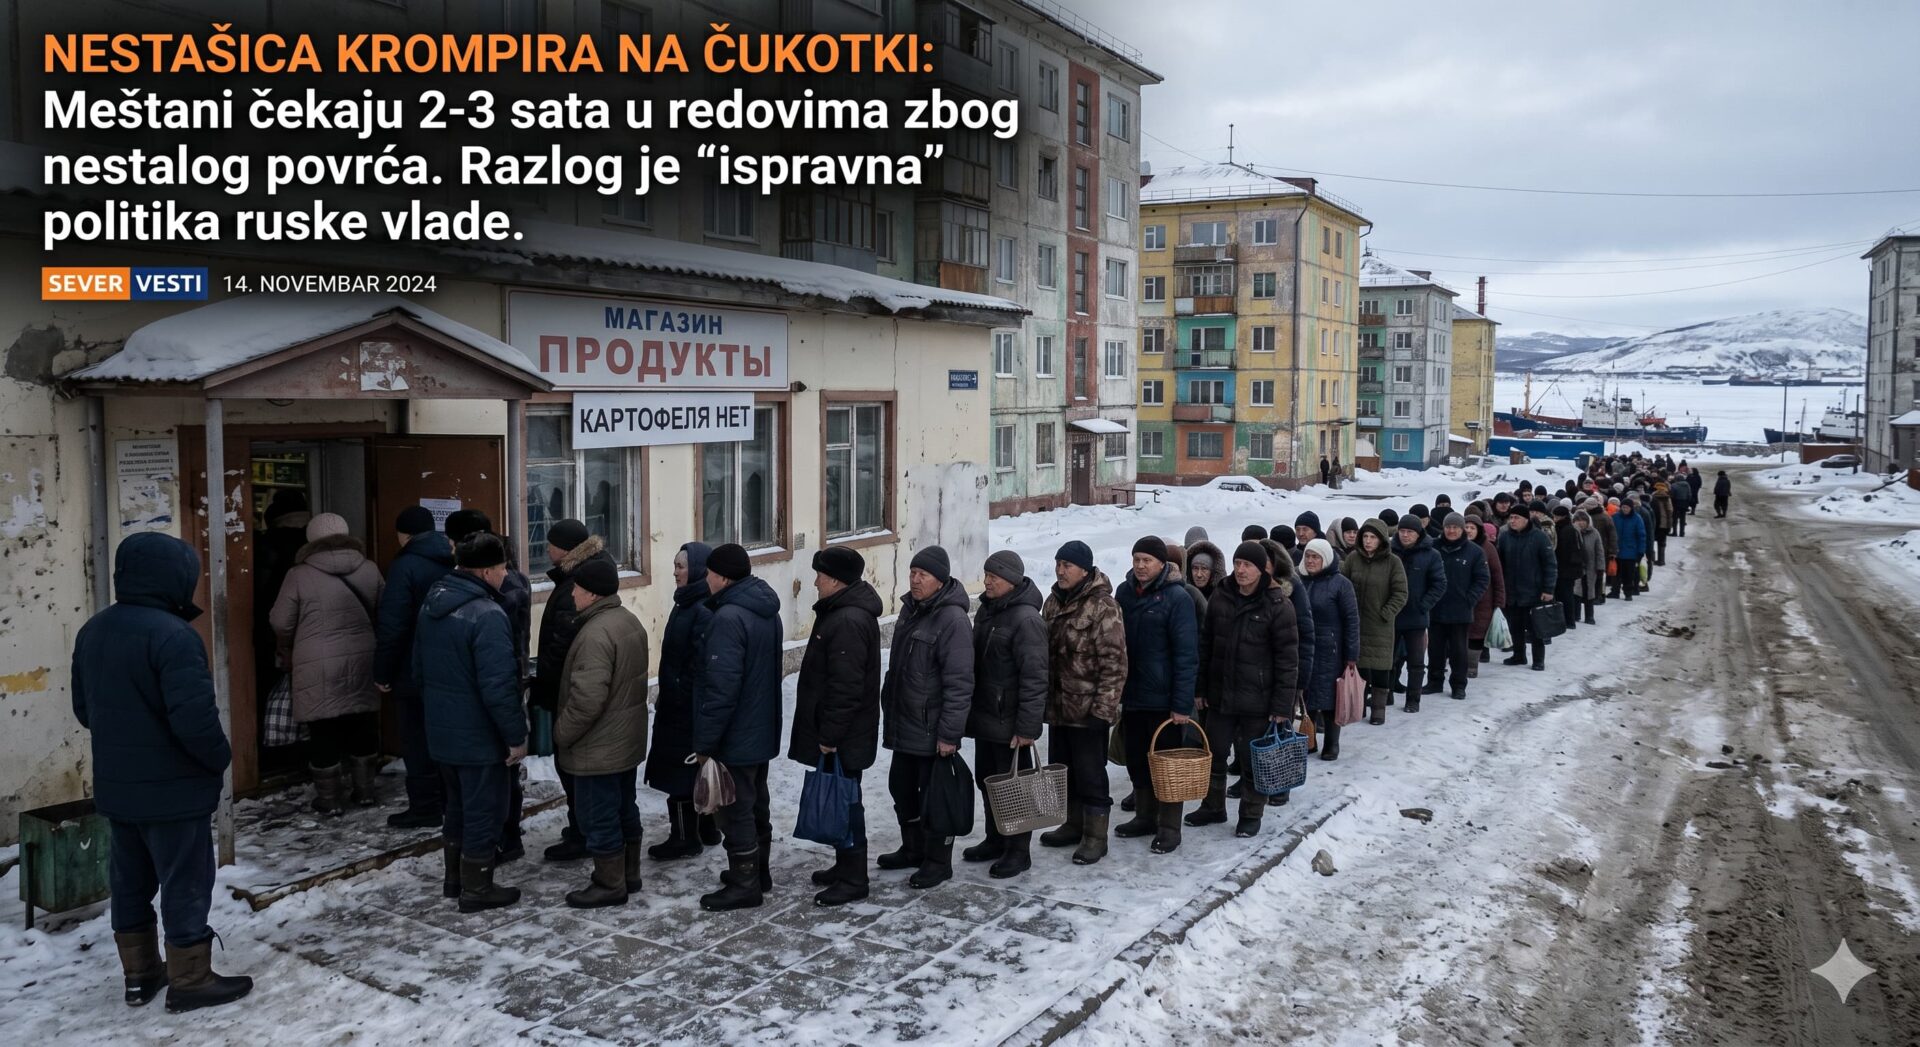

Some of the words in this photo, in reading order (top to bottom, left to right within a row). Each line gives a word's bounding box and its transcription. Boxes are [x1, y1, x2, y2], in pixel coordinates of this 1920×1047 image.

[605, 306, 723, 335] МАГАЗИН
[539, 335, 772, 383] ПРОДУКТЫ
[580, 405, 710, 433] КАРТОФЕЛЯ
[716, 405, 751, 428] НЕТ
